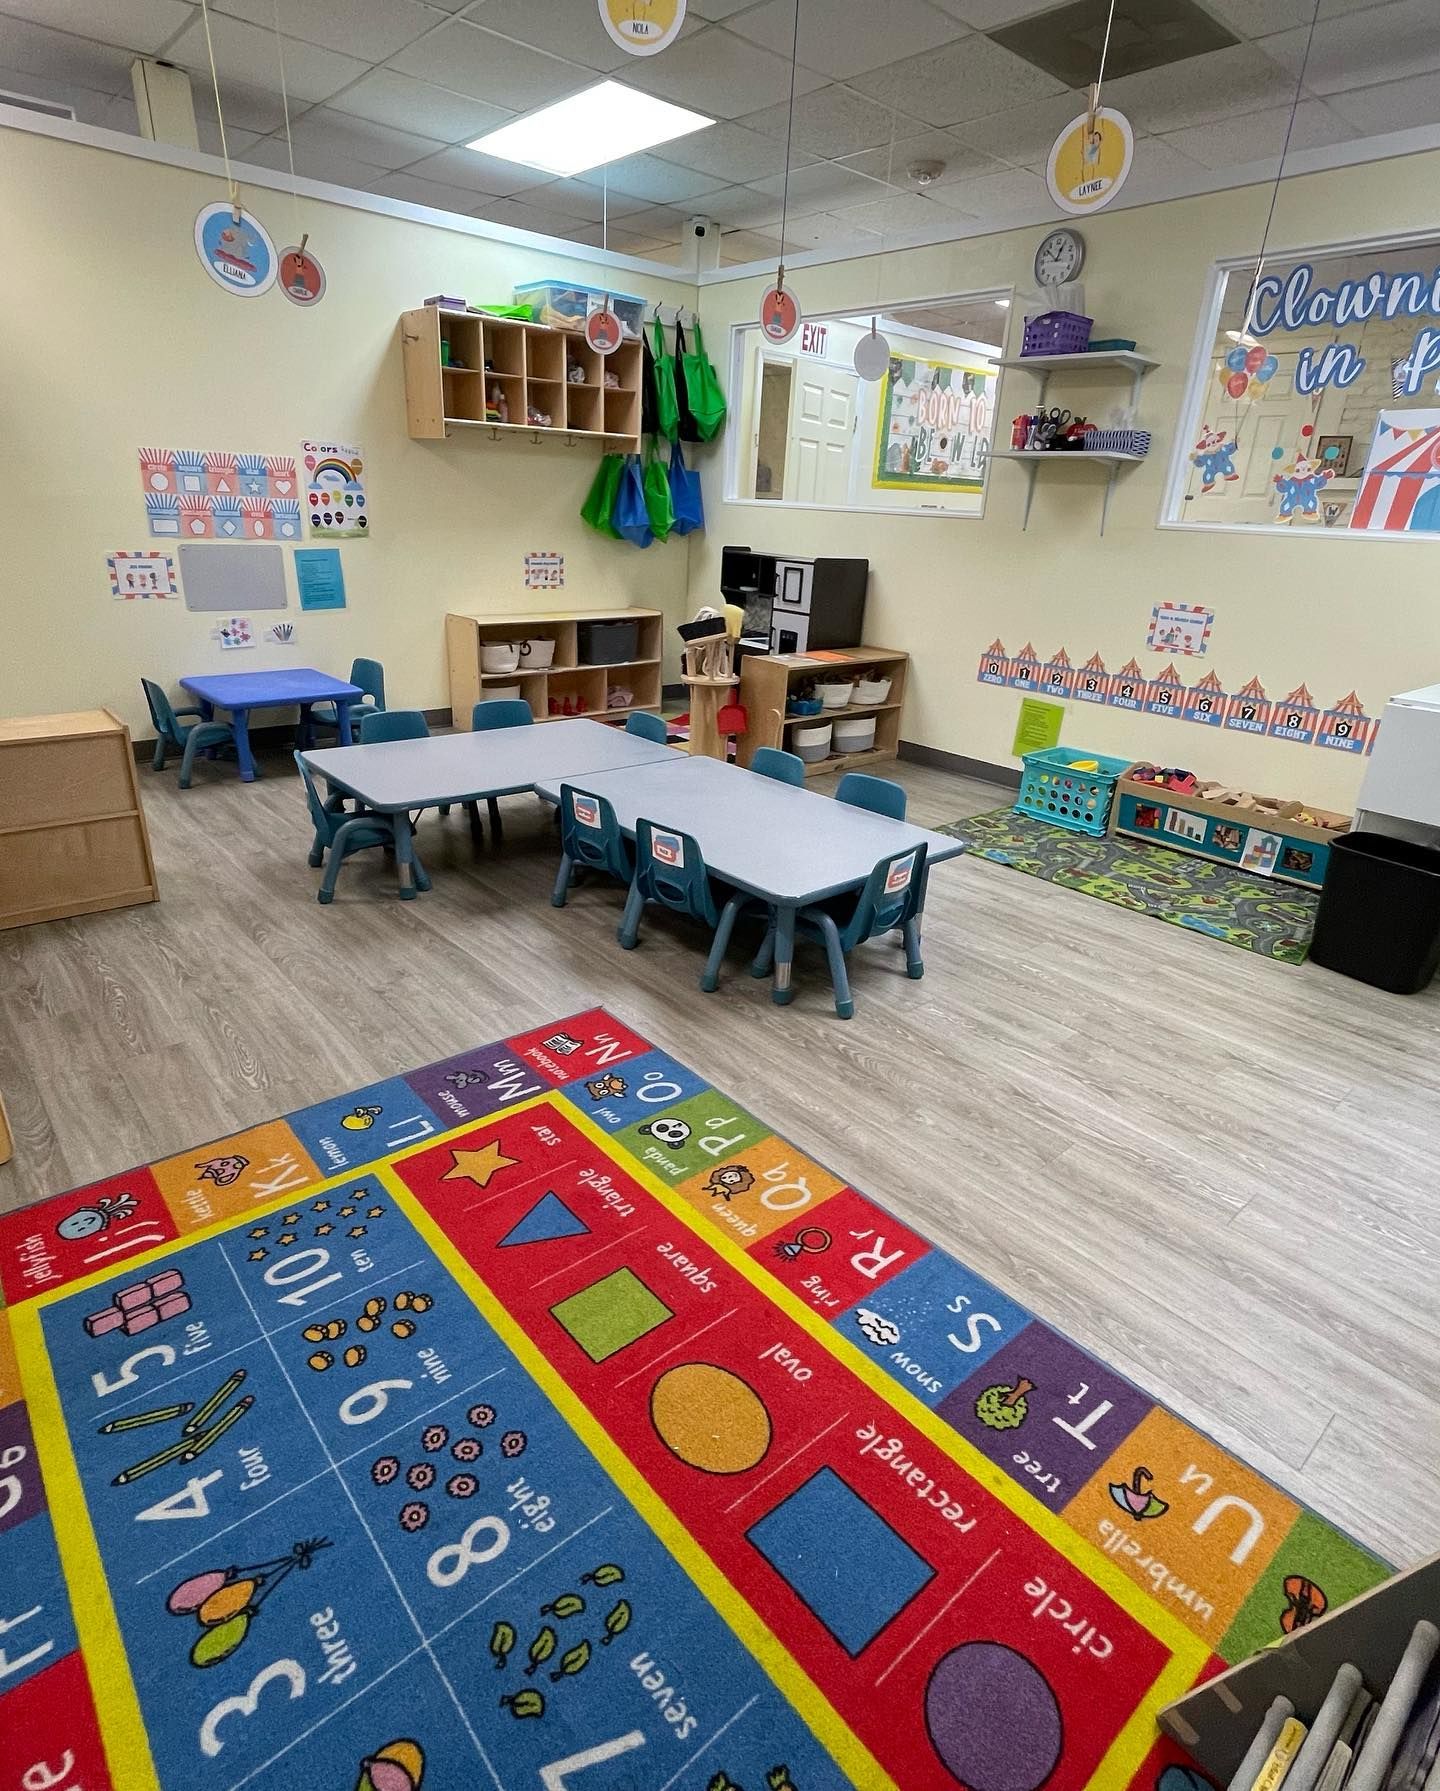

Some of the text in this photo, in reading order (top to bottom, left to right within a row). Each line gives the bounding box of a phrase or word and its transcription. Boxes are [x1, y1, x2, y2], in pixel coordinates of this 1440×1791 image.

[632, 23, 649, 34] NOLA
[1079, 179, 1103, 196] LAYNEE
[802, 323, 826, 355] EXIT
[1295, 343, 1366, 395] in
[917, 387, 986, 432] BORN TO
[983, 674, 1002, 683] ZERO
[990, 665, 997, 674] 0
[1015, 679, 1030, 688] ONE
[1021, 669, 1027, 679] 1
[1054, 675, 1061, 685] 2
[1046, 685, 1064, 695] TWO
[1077, 690, 1102, 701] THREE
[1088, 681, 1095, 690] 3
[1122, 686, 1131, 697] 4
[1160, 693, 1168, 704] 5
[1113, 696, 1137, 709] FOUR
[1151, 704, 1174, 715] FIVE
[1193, 711, 1211, 722] SIX
[1200, 701, 1209, 711] 6
[1244, 708, 1253, 719] 7
[1229, 719, 1263, 732] SEVEN
[1274, 726, 1308, 741] EIGHT
[1289, 716, 1298, 728] 8
[1338, 724, 1348, 736] 9
[1325, 735, 1354, 749] NINE
[523, 1047, 569, 1080] notebook
[438, 1090, 470, 1117] mouse
[592, 1108, 621, 1123] owl
[531, 1126, 561, 1145] star
[319, 1137, 349, 1170] lemon
[643, 1147, 689, 1176] panda
[577, 1169, 635, 1217] triangle
[712, 1203, 757, 1236] queen
[16, 1233, 62, 1288] jellyfish
[351, 1249, 374, 1272] ten
[657, 1242, 717, 1293] square
[264, 1248, 342, 1305] 10
[800, 1276, 839, 1306] ring
[183, 1322, 212, 1355] five
[92, 1345, 177, 1397] 5
[418, 1348, 452, 1384] nine
[759, 1343, 813, 1381] oval
[890, 1352, 942, 1393] snow
[338, 1378, 413, 1425] 9
[238, 1447, 271, 1490] four
[856, 1424, 974, 1533] rectangle
[1013, 1451, 1060, 1492] tree
[135, 1469, 223, 1520] 4
[506, 1477, 555, 1530] eight
[427, 1516, 510, 1587] 8
[1098, 1519, 1214, 1621] umbrella
[1024, 1576, 1113, 1658] circle
[310, 1607, 357, 1684] three
[200, 1659, 305, 1757] 3
[629, 1652, 697, 1739] seven
